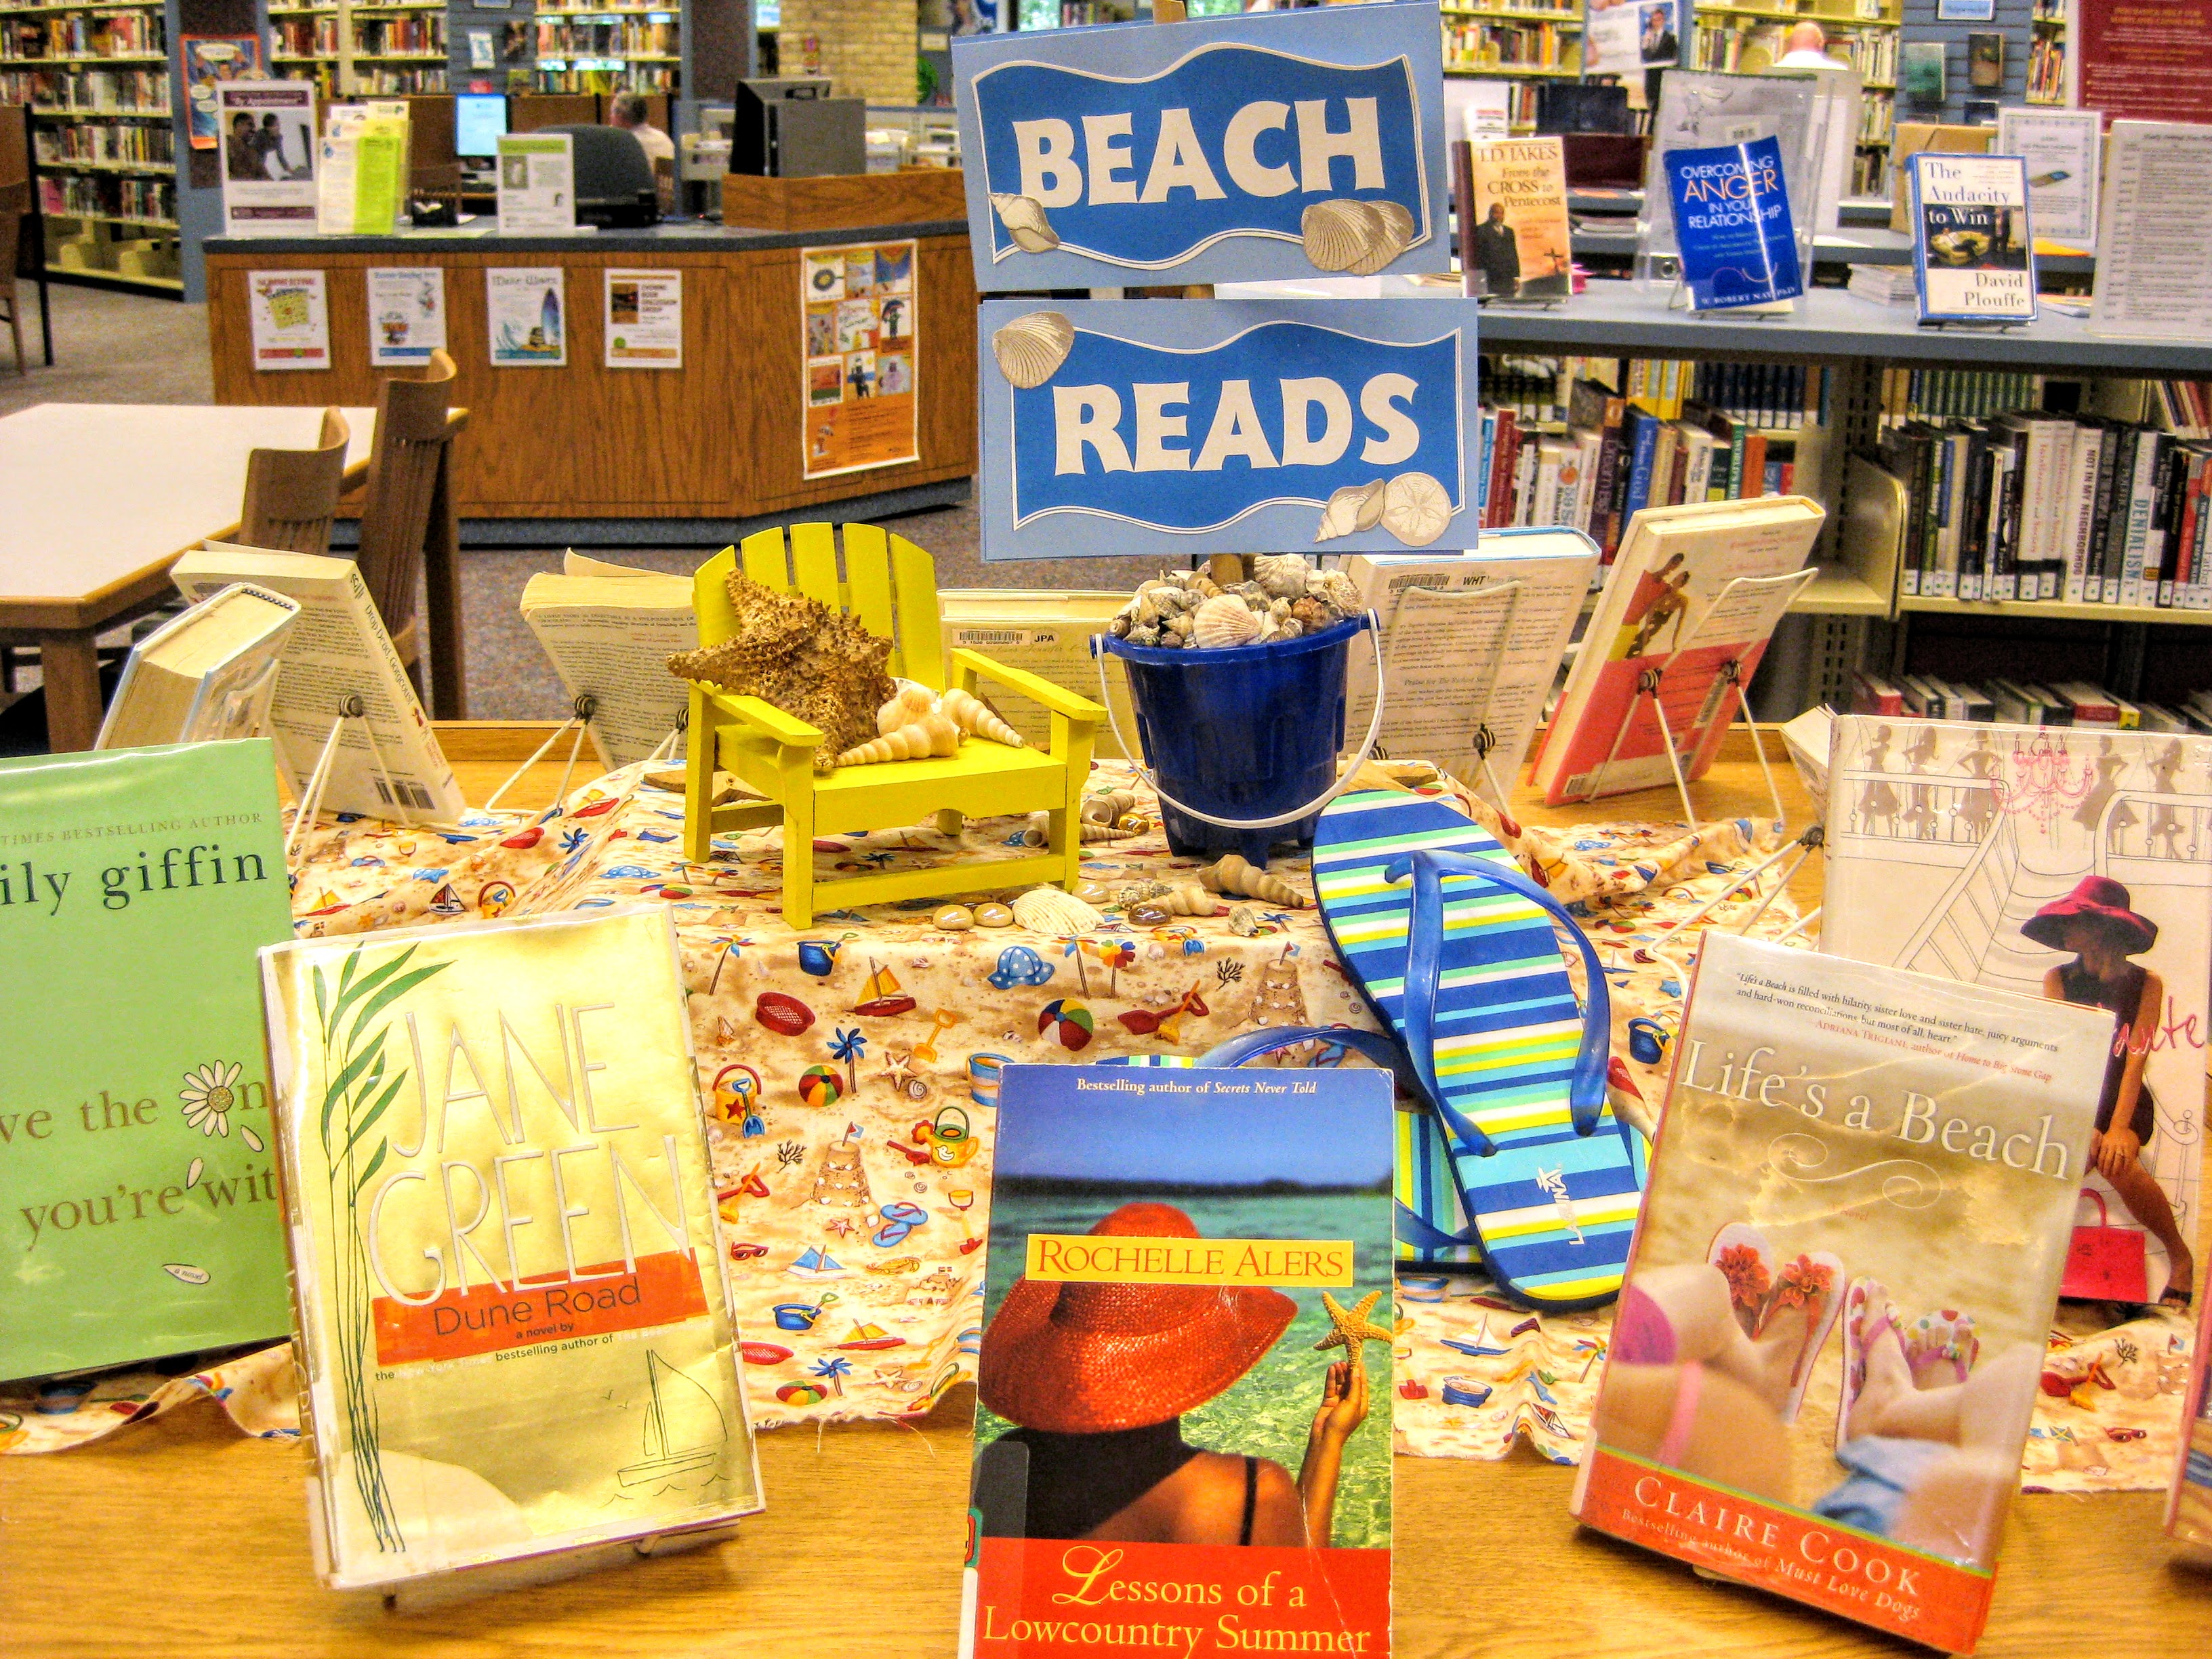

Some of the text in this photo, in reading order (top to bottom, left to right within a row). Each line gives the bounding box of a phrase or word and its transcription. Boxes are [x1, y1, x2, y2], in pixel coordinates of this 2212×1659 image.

[1012, 97, 1387, 208] BEACH
[1476, 146, 1558, 161] T.D. JAKES
[1502, 165, 1550, 178] From the
[1680, 156, 1774, 179] OVERCOMNG
[1925, 161, 1961, 180] The
[1487, 180, 1539, 194] CROSS
[1504, 196, 1561, 207] Pentecost
[1683, 169, 1779, 203] ANGER
[1929, 185, 2011, 204] Audacity
[1708, 199, 1755, 214] IN YOU
[1928, 207, 1988, 225] to Win
[1714, 292, 1750, 304] ROBERT
[1964, 292, 2025, 307] Plouffe
[1975, 272, 2024, 287] David
[1053, 373, 1420, 476] READS
[2072, 449, 2096, 576] NOT IN MY NEIGHBORHOO
[1462, 576, 1487, 586] WHT
[365, 605, 415, 705] Drop Dead, Gorgeous!
[0, 812, 263, 847] TIMES BESTSELLING AUTHOR
[0, 843, 268, 916] ily giffin
[1736, 989, 1753, 999] and
[1754, 989, 1795, 1008] hard-won
[1861, 1015, 1876, 1027] but
[1877, 1021, 1899, 1032] most
[1900, 1024, 1911, 1035] of
[1765, 979, 1787, 991] Beach
[1789, 985, 1796, 994] is
[1797, 985, 1820, 999] filled
[1821, 991, 1840, 1004] with
[1874, 1004, 1898, 1017] sister
[1899, 1008, 1918, 1021] love
[1919, 1015, 1937, 1025] and
[1938, 1019, 1963, 1031] sister
[1964, 1022, 1985, 1037] hate,
[1986, 1029, 2010, 1044] juicy
[2010, 1036, 2059, 1052] arguments
[391, 1002, 639, 1158] JANE
[1910, 1044, 1942, 1056] author
[1944, 1050, 1954, 1059] of
[1956, 1051, 1981, 1066] Home
[1982, 1057, 1991, 1067] to
[1993, 1060, 2008, 1074] Big
[2034, 1069, 2053, 1084] Gap
[1076, 1078, 1317, 1095] Bestselling author of Secrets Never Told
[0, 1108, 53, 1144] ve
[79, 1090, 159, 1132] the
[1681, 1039, 2069, 1181] Life's a Beach
[20, 1163, 278, 1252] you're wit
[368, 1134, 695, 1307] GREEN
[174, 1267, 205, 1281] a novel
[1037, 1239, 1343, 1279] ROCHELLE ALERS
[433, 1276, 641, 1337] Dune Road
[516, 1320, 575, 1340] a novel by
[375, 1371, 395, 1382] the
[495, 1343, 558, 1361] bestselling
[561, 1334, 598, 1351] author
[601, 1332, 615, 1345] of
[1634, 1475, 1922, 1597] CLAIRE COOK
[1051, 1544, 1307, 1607] Lessons of a
[1622, 1507, 1921, 1622] Bestselling author of Must Love Dogs
[983, 1605, 1372, 1659] Lowcountry Summer
